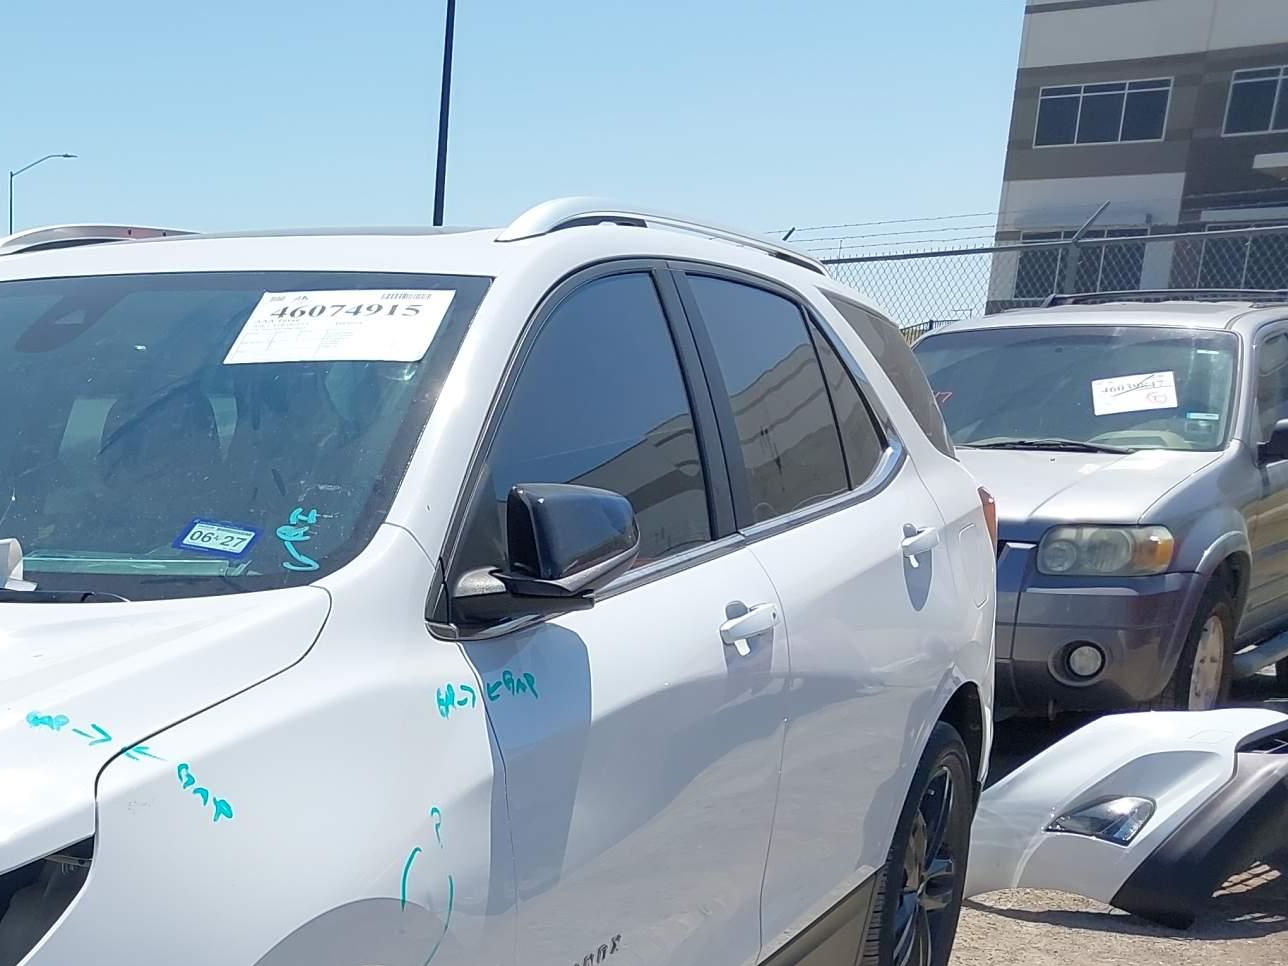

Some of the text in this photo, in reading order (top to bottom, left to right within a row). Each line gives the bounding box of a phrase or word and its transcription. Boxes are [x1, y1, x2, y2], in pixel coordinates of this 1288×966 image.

[270, 304, 424, 318] 46074915
[189, 530, 214, 543] 06
[220, 535, 248, 549] 27
